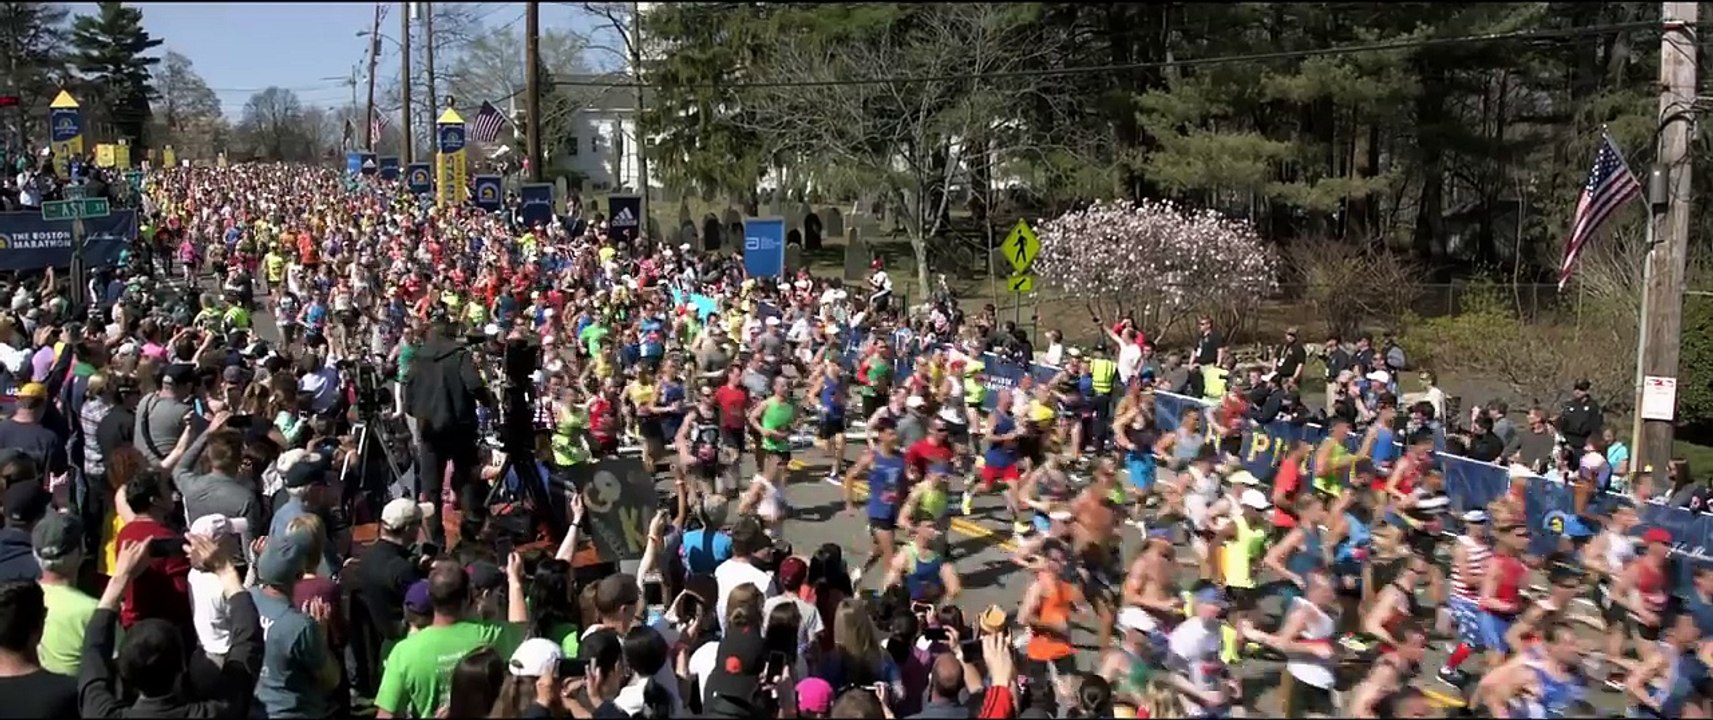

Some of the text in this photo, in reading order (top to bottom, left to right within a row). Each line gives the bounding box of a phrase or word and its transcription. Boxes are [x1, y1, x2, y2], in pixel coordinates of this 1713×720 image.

[62, 200, 87, 217] ASH
[12, 232, 71, 241] THE BOSTON
[13, 240, 72, 249] MARATHON
